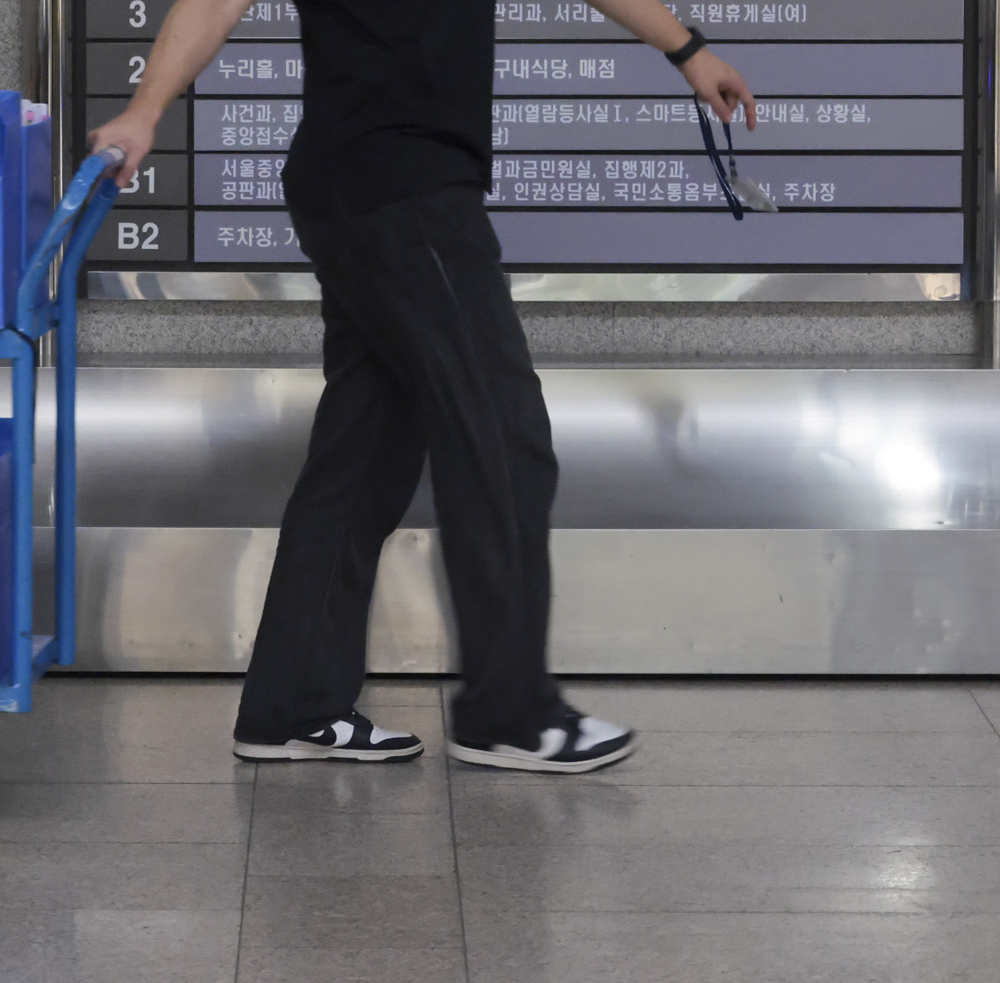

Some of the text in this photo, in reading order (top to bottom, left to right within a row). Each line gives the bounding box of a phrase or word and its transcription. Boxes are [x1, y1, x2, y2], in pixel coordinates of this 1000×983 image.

[129, 0, 146, 27] 3
[128, 56, 145, 83] 2
[219, 59, 278, 79] 누리홀,
[580, 59, 614, 78] 매점
[222, 105, 275, 123] 사건과,
[816, 104, 870, 123] 상황실,
[605, 161, 688, 179] 집행제2과,
[515, 183, 605, 201] 인권상담실,
[784, 183, 835, 202] 주차장
[118, 222, 159, 249] B2
[218, 227, 277, 247] 주차장,
